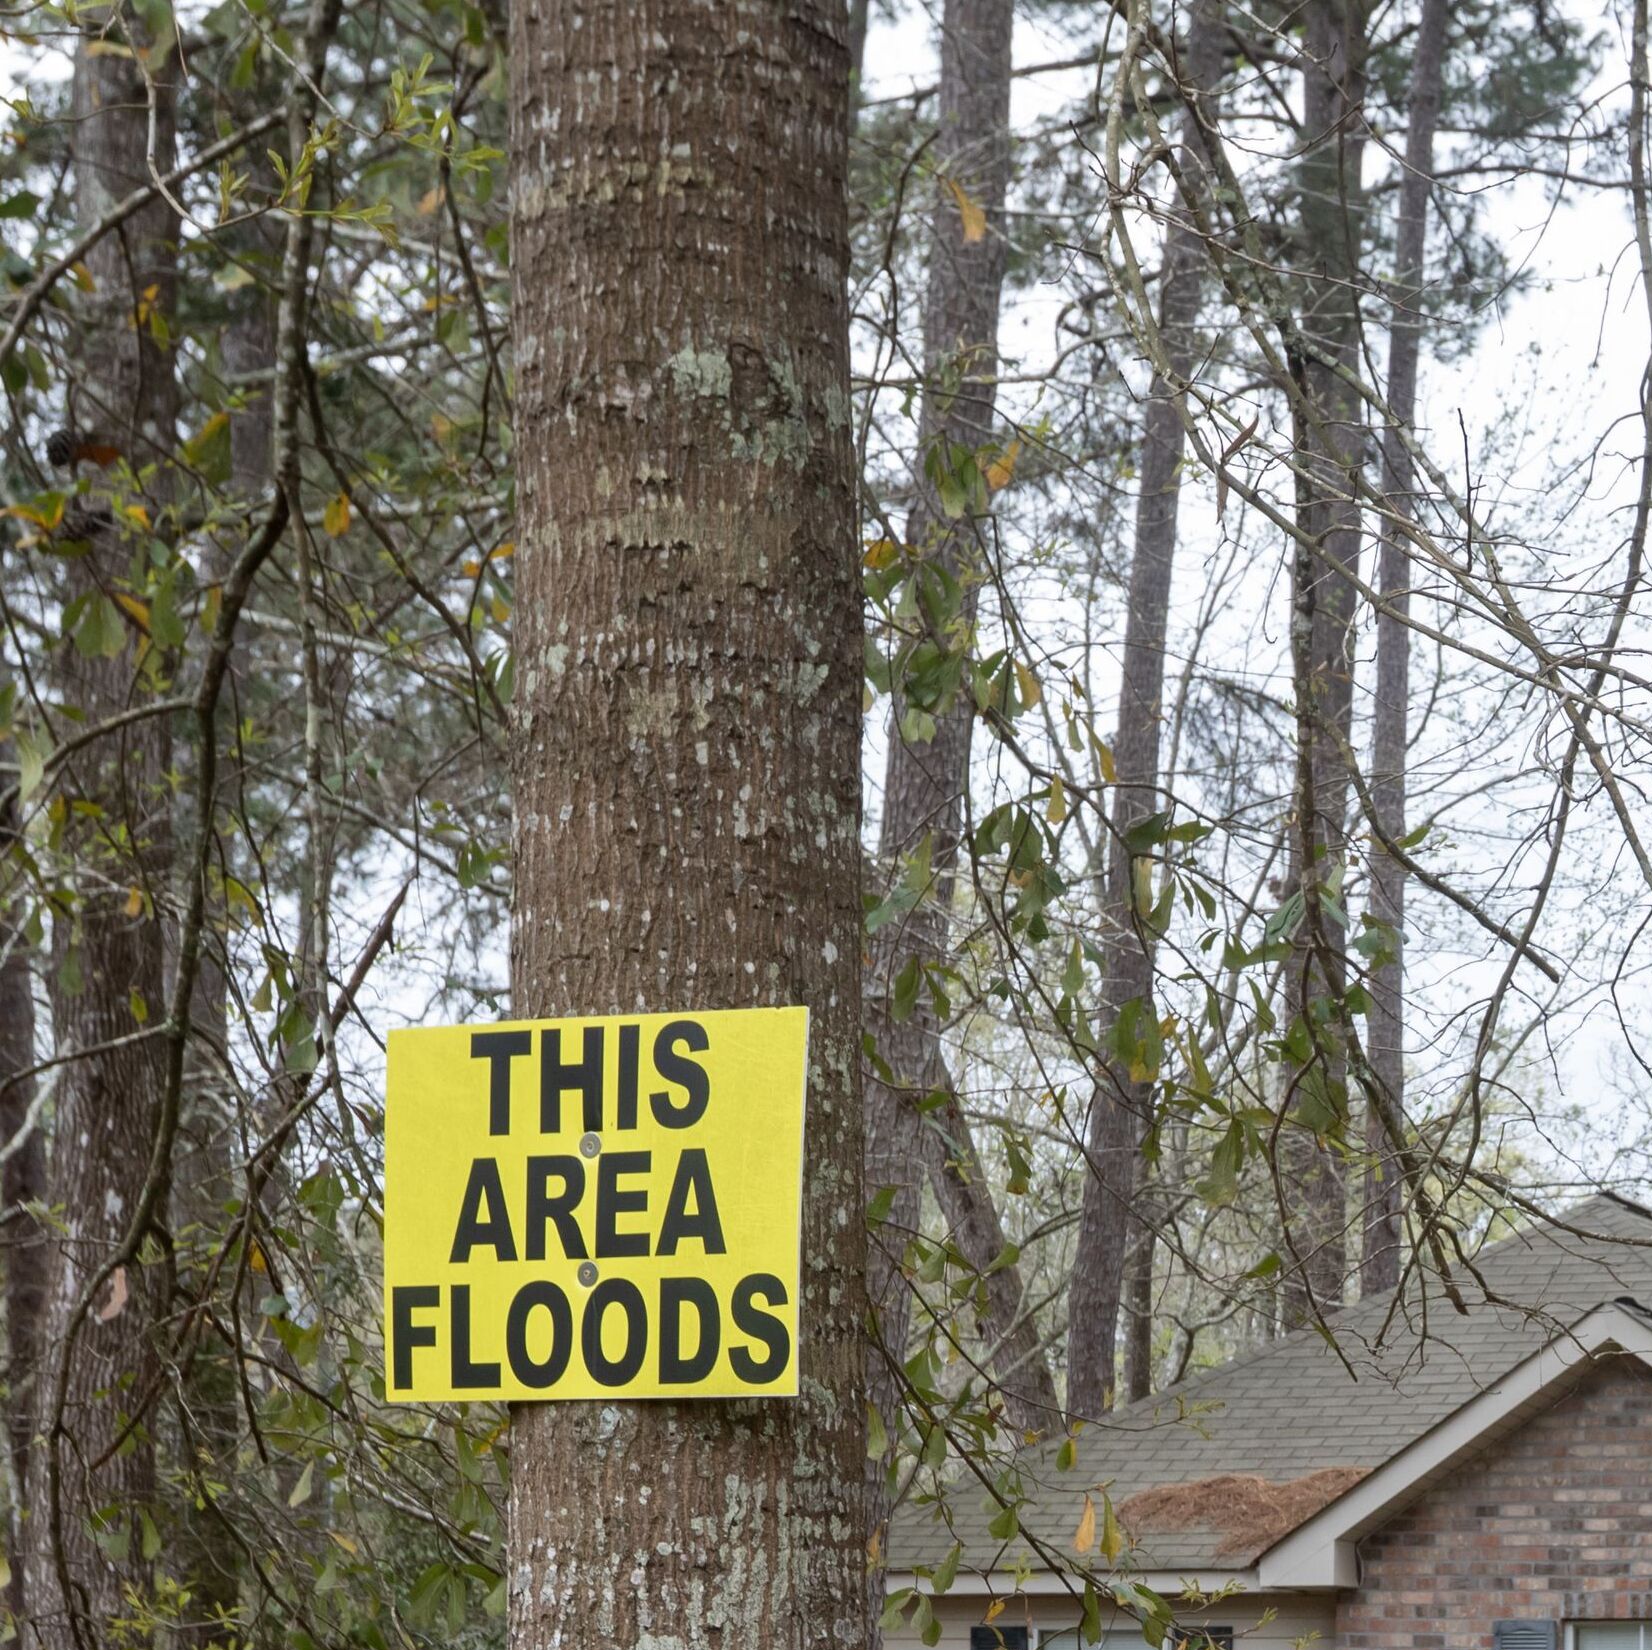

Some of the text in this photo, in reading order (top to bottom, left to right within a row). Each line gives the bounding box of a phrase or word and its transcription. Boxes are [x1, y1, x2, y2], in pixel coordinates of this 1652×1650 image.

[470, 1020, 710, 1136] THIS
[449, 1148, 727, 1263] AREA
[392, 1273, 790, 1391] FLOODS
